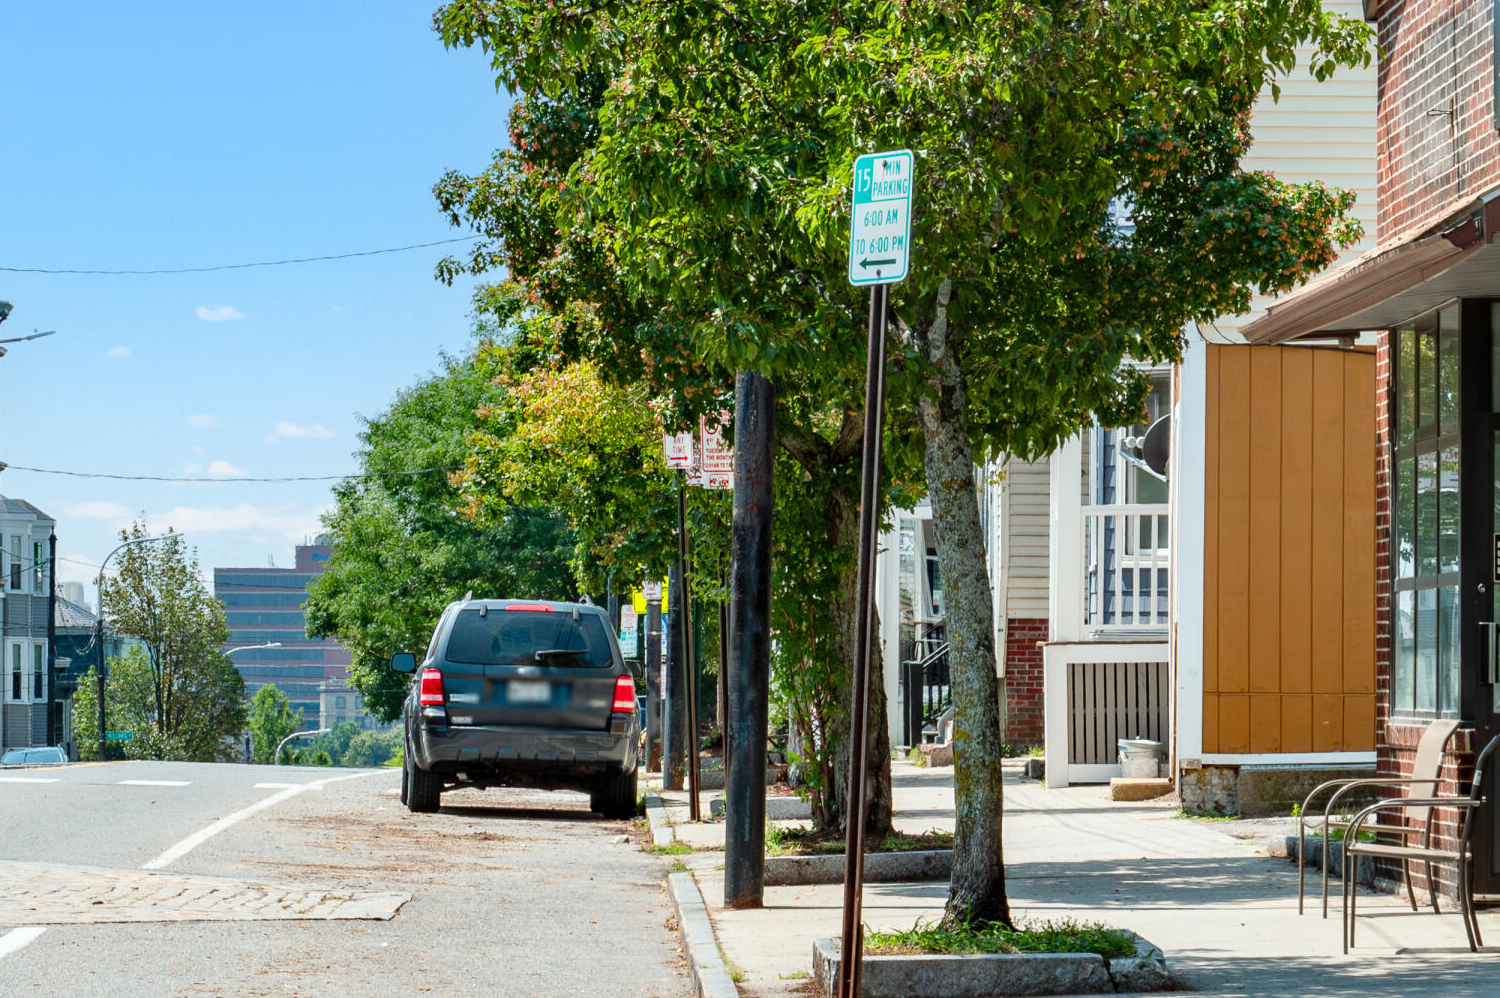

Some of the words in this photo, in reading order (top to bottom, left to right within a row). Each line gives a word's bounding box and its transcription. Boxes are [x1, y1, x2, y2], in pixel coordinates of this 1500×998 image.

[885, 159, 901, 177] MIN
[858, 168, 871, 192] 15
[873, 178, 908, 197] PARKING
[863, 209, 883, 227] 6:00
[885, 208, 898, 225] AM
[856, 238, 866, 255] TO
[869, 236, 889, 254] 6:00
[891, 234, 904, 252] PM
[672, 445, 687, 454] TIME
